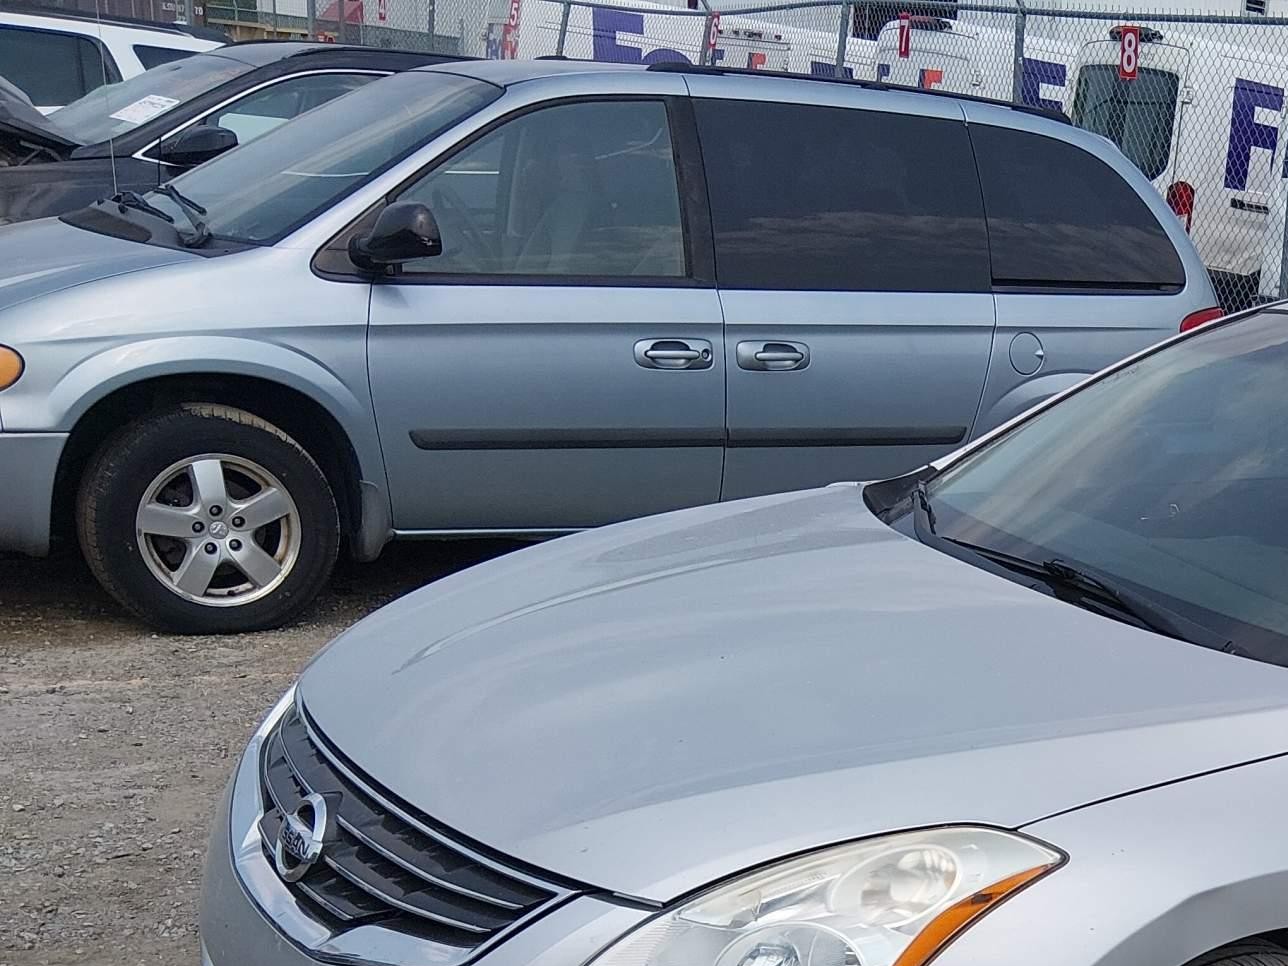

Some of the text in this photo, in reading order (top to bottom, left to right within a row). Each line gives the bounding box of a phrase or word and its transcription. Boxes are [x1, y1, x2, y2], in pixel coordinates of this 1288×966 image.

[510, 2, 519, 26] 5
[709, 18, 719, 46] 6
[901, 19, 910, 52] 7
[1122, 32, 1136, 73] 8
